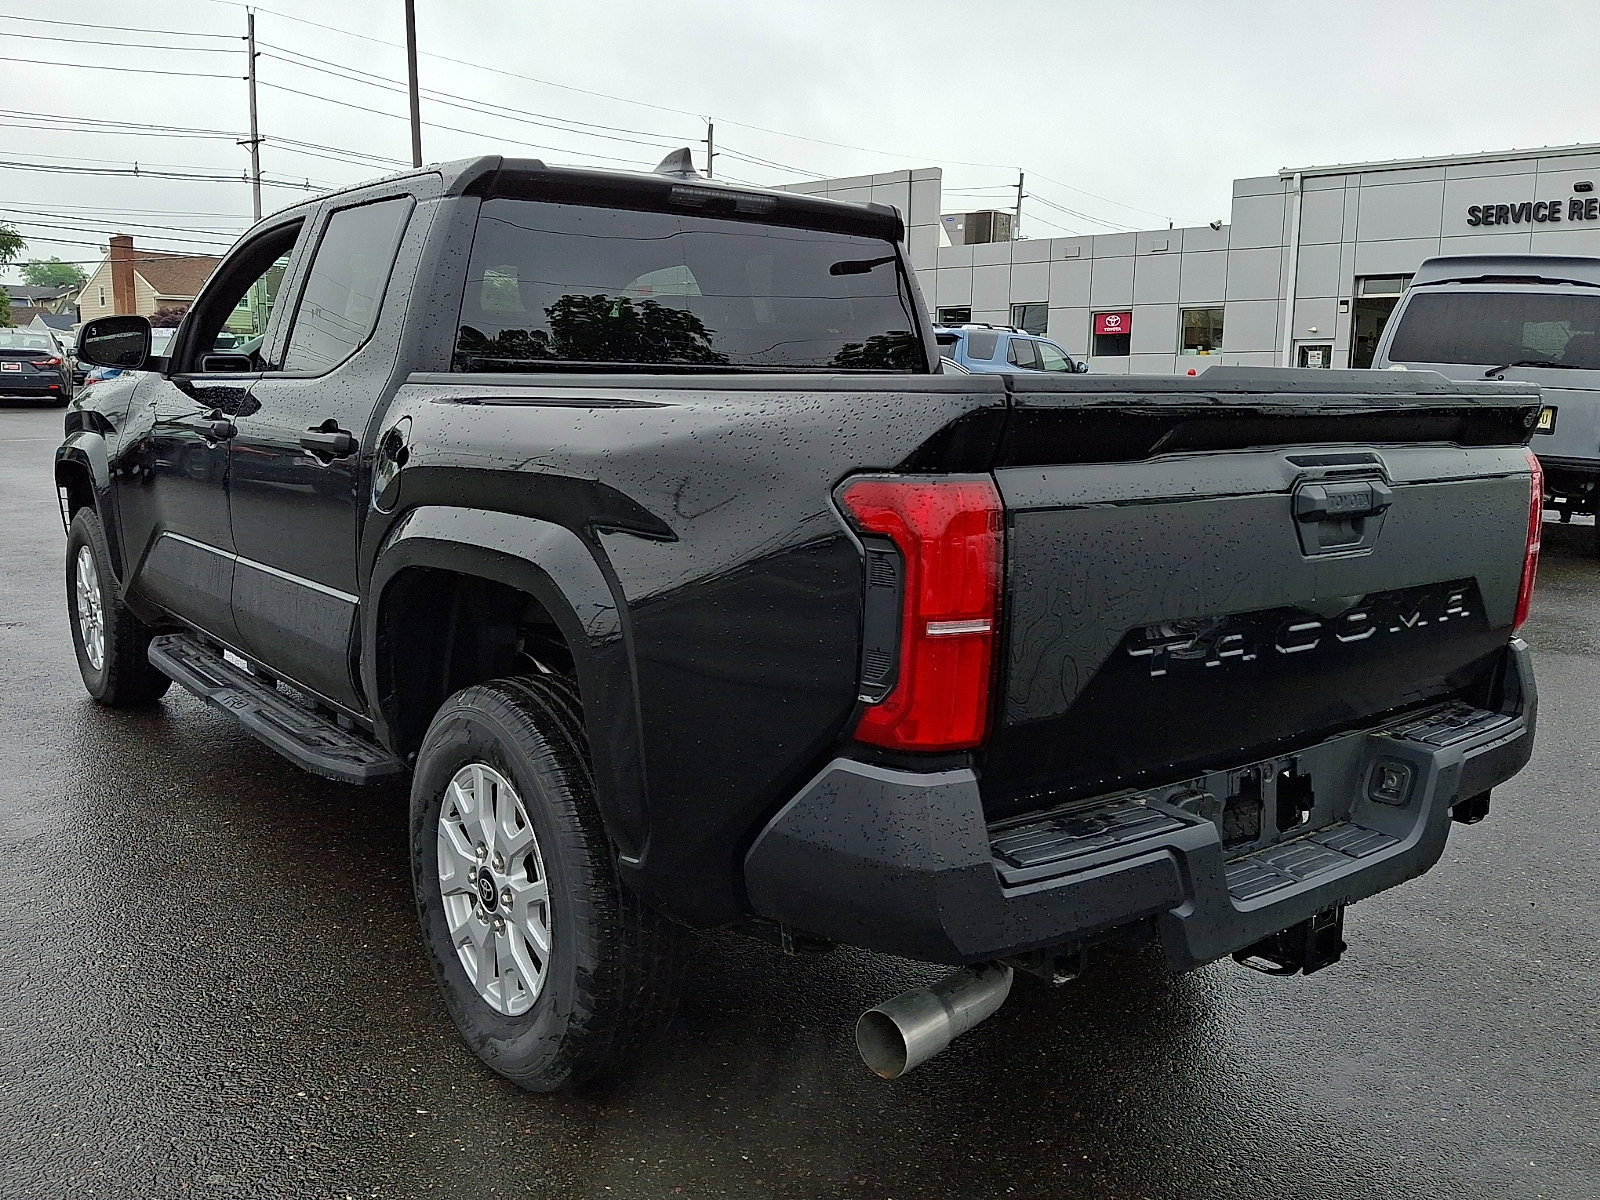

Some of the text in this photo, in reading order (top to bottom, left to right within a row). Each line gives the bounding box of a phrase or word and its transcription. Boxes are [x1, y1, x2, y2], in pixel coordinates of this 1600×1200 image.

[1467, 197, 1600, 226] SERVICE RE
[1327, 493, 1371, 510] TOYOTA
[1127, 586, 1472, 677] TACOMA
